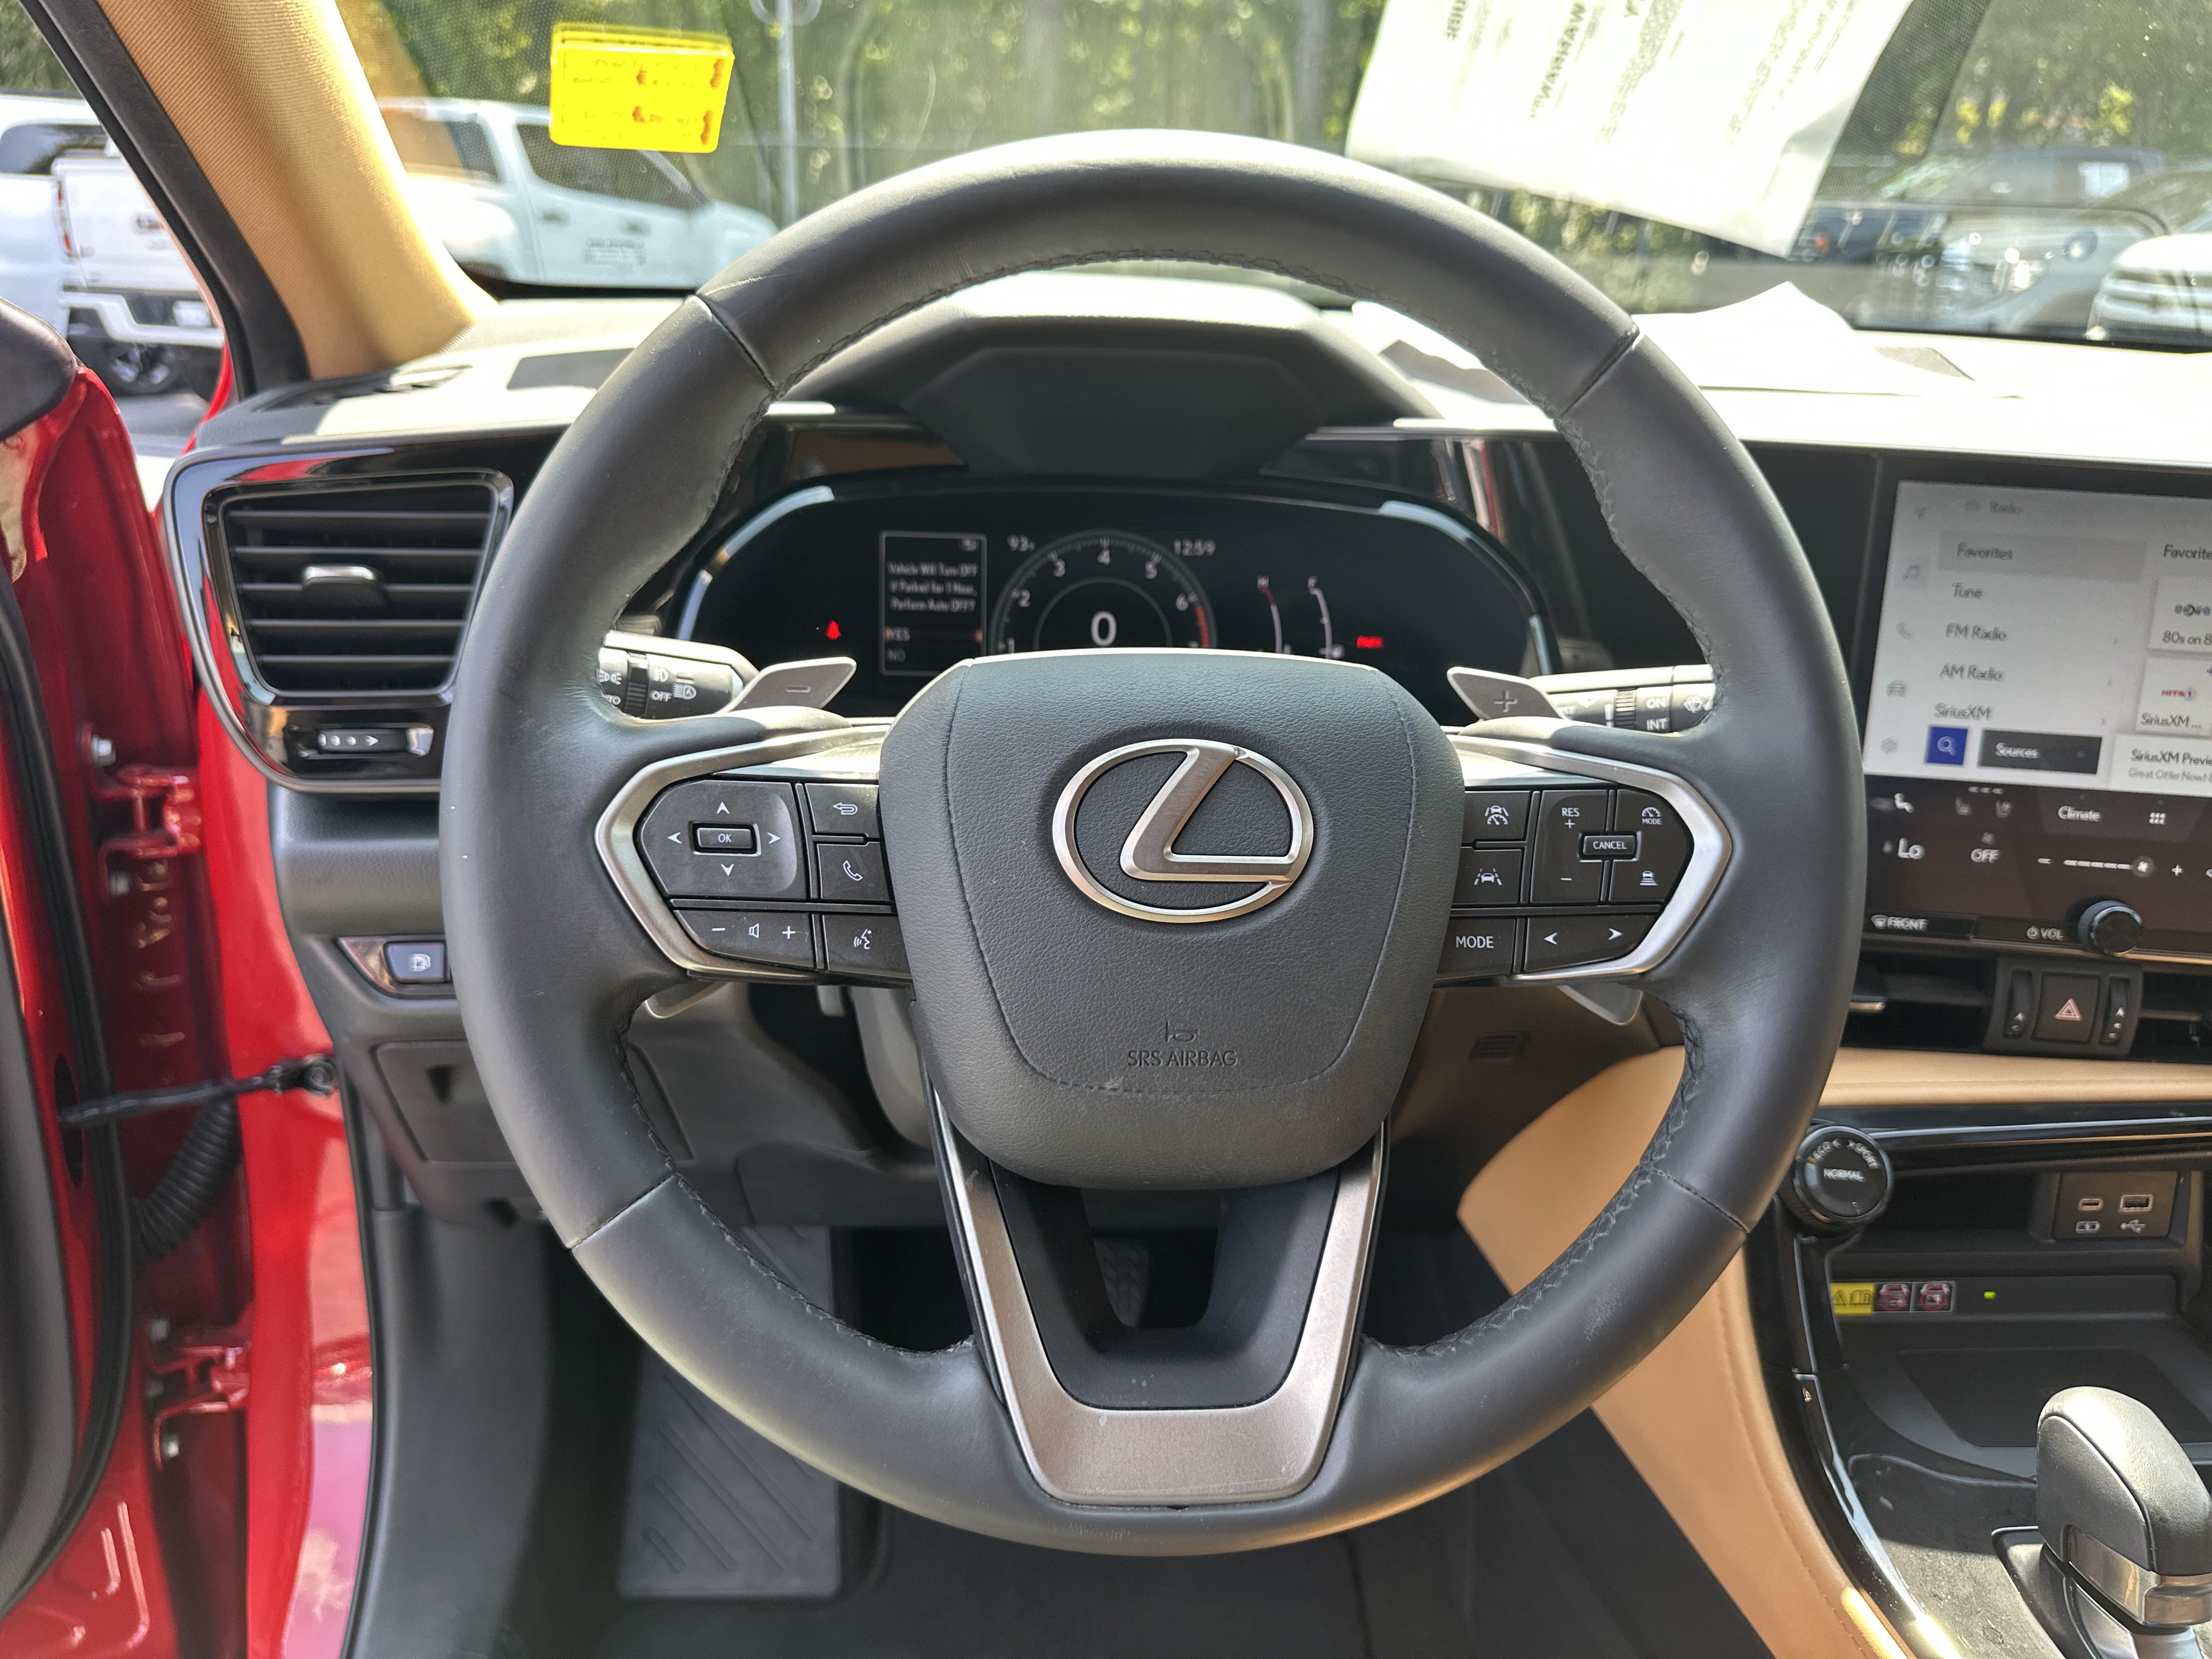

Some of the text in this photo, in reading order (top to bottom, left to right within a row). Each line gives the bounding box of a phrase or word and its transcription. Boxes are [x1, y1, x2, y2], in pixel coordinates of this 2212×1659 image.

[1098, 549, 1111, 566] 4
[1957, 541, 2013, 561] Favorites
[1053, 558, 1065, 577] 3
[1145, 561, 1158, 579] 5
[1018, 589, 1030, 607] 2
[1951, 582, 1984, 600] Tune
[1176, 594, 1188, 611] 6
[1091, 611, 1117, 646] 0
[1945, 623, 2007, 641] FM Radio
[2162, 630, 2185, 645] 80s
[2187, 636, 2201, 645] on
[1939, 663, 2004, 681] AM Radio
[650, 690, 672, 702] OFF
[1646, 698, 1667, 709] ON
[1934, 702, 1993, 721] SiriusXM
[1646, 719, 1669, 731] INT
[2141, 713, 2190, 727] SiriusXM
[1995, 742, 2039, 759] Sources
[2131, 749, 2179, 763] SiriusXM
[2129, 768, 2154, 779] Great
[1562, 808, 1579, 817] RES
[2058, 805, 2102, 821] Climate
[718, 833, 732, 843] OK
[1593, 841, 1627, 850] CANCEL
[1971, 849, 2001, 864] OFF
[1888, 917, 1928, 932] FRONT
[2040, 928, 2064, 941] VOL
[1455, 936, 1494, 949] MODE
[1127, 1049, 1238, 1067] SRS AIRBAG
[1854, 1143, 1880, 1169] SPORT
[1824, 1169, 1866, 1182] NORMAL
